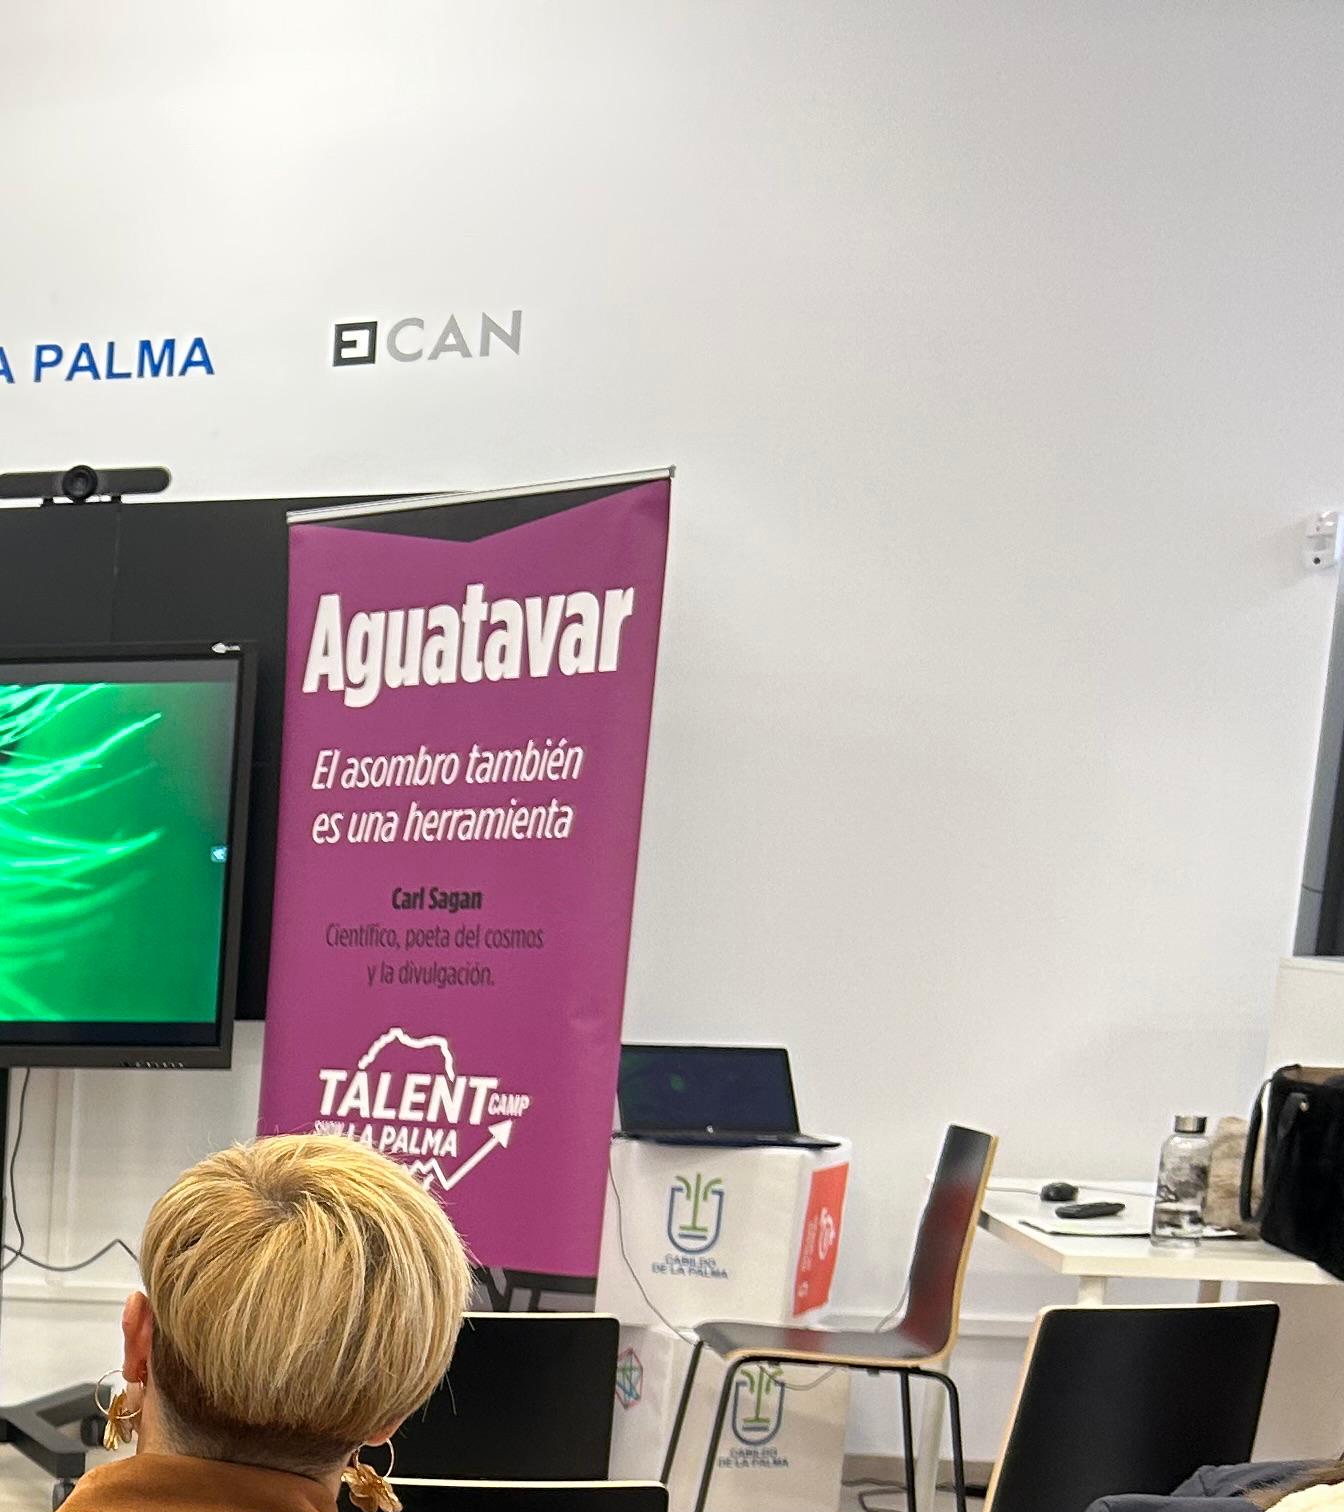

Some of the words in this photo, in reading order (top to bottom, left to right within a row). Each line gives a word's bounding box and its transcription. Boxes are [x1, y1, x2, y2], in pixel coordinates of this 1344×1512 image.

[33, 336, 216, 383] PALMA
[302, 583, 635, 708] Aguatavar
[311, 749, 341, 790] El
[340, 744, 459, 789] asombro
[465, 737, 584, 784] también
[312, 811, 344, 844] es
[346, 810, 400, 843] una
[402, 798, 574, 842] herramienta
[391, 886, 425, 910] Carl
[428, 886, 483, 913] Sagan
[405, 924, 451, 950] poeta
[454, 923, 481, 948] del
[484, 927, 545, 949] cosmos
[367, 964, 378, 987] y
[380, 960, 394, 985] la
[398, 960, 495, 989] divulgación.
[487, 1092, 530, 1117] CAMP
[378, 1124, 458, 1158] PALMA
